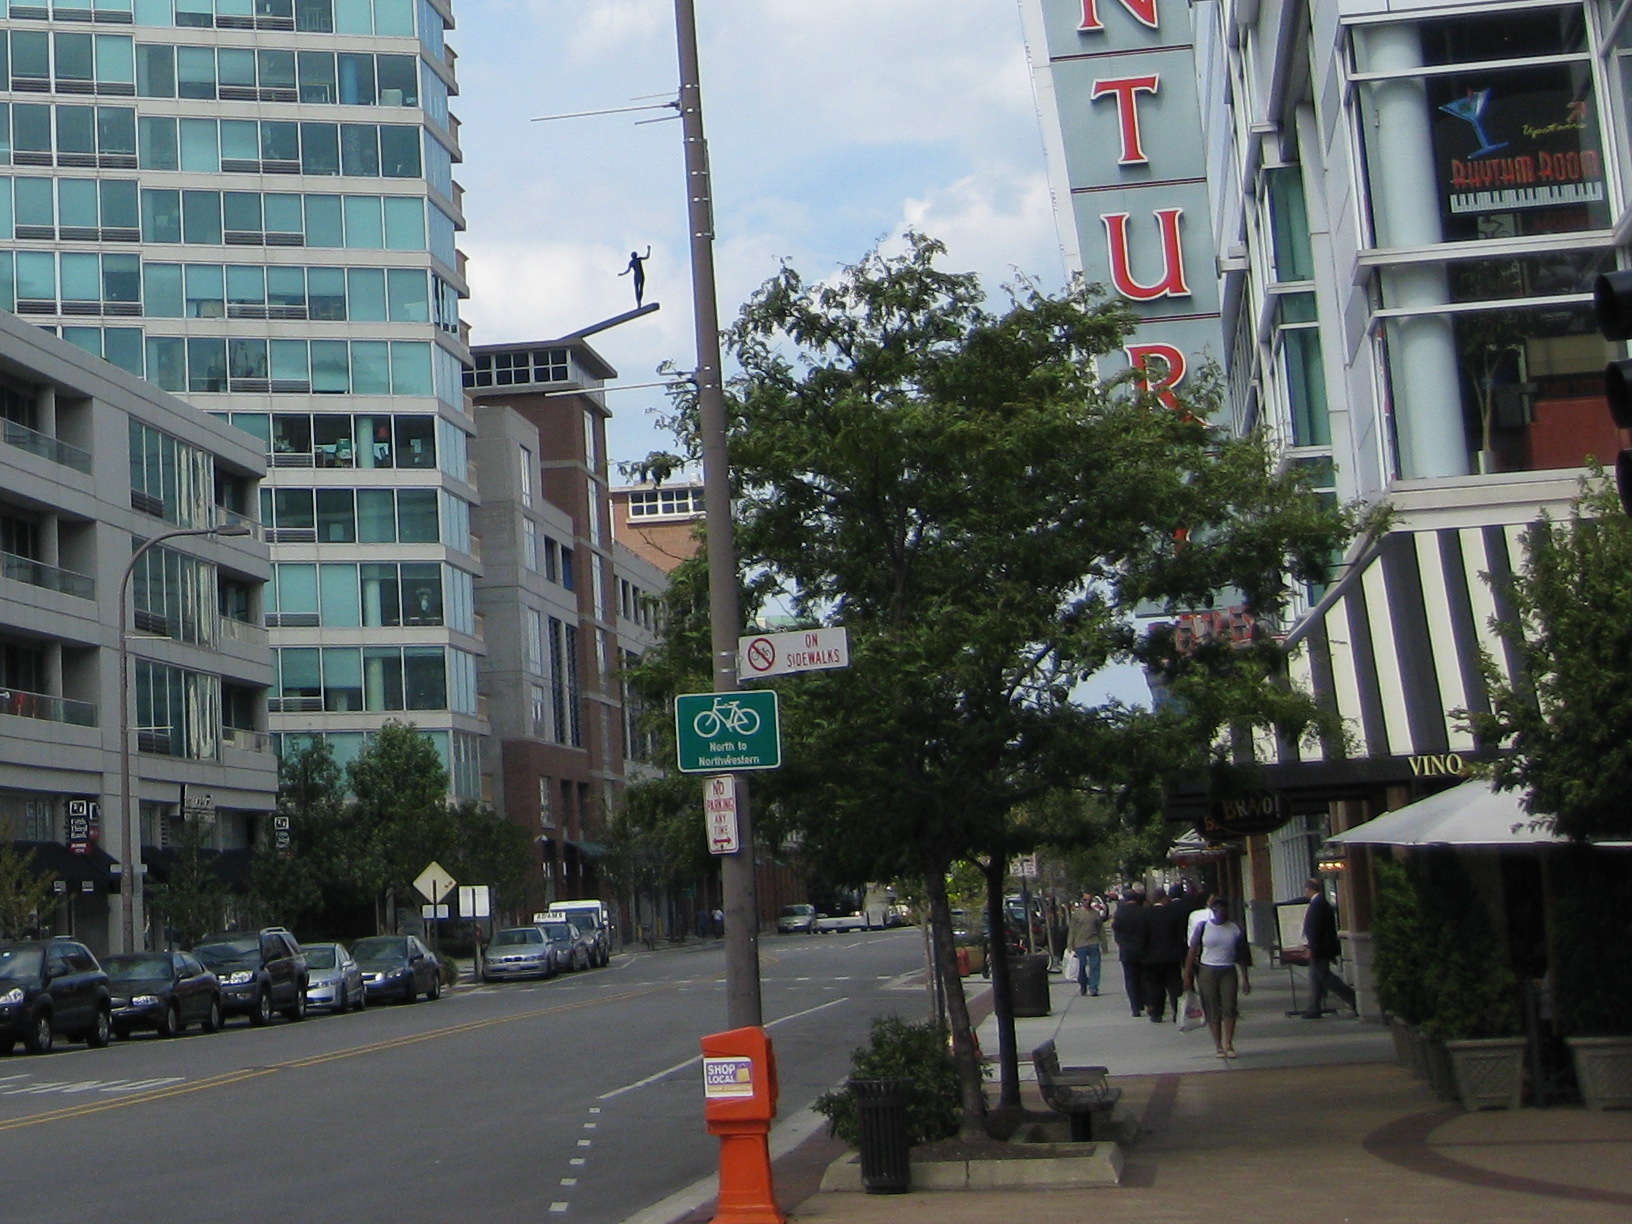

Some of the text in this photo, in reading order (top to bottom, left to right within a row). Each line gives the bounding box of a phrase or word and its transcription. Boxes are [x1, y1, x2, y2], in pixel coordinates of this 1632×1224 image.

[1450, 150, 1600, 189] RHYTHM ROOM
[804, 633, 819, 649] ON
[786, 648, 841, 668] SIDEWALKS
[709, 741, 748, 752] North to
[698, 755, 760, 767] Northwestern
[1408, 753, 1463, 776] VINO
[713, 781, 725, 796] NO
[706, 797, 735, 812] PARKING
[714, 815, 727, 824] ANY
[714, 825, 729, 836] TIME
[708, 1064, 736, 1075] SHOP
[708, 1075, 736, 1084] LOCAL
